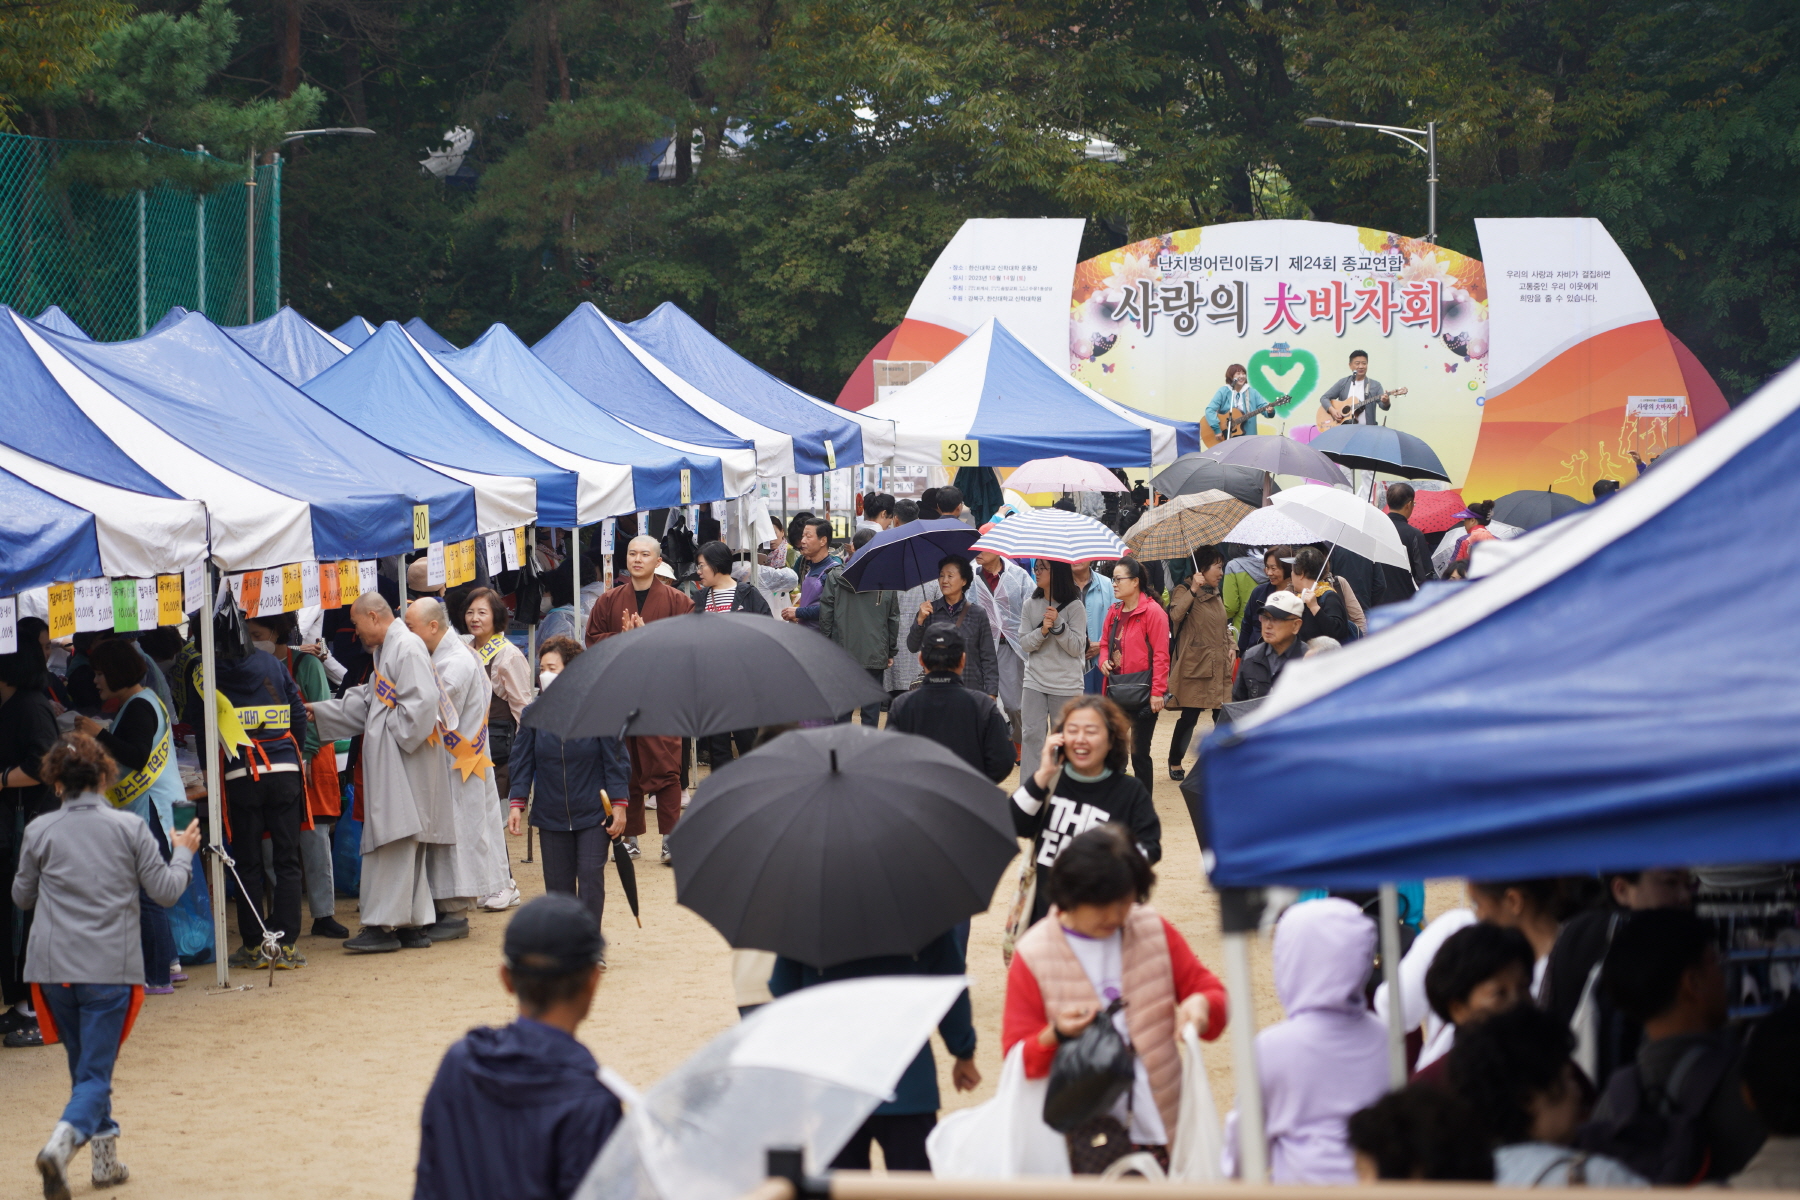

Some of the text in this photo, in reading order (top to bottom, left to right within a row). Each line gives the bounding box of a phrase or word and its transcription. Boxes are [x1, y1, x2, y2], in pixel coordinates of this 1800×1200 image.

[1158, 255, 1403, 272] 난치병어린이돕기 제24회 종교연합
[1506, 270, 1611, 279] 우리의 사랑과 자비가 결집하면
[1519, 282, 1598, 291] 고통중인 우리 이웃에게
[1112, 280, 1244, 334] 사랑의
[1520, 294, 1597, 303] 희망을 줄 수 있습니다.
[948, 443, 972, 462] 39
[415, 512, 427, 541] 30
